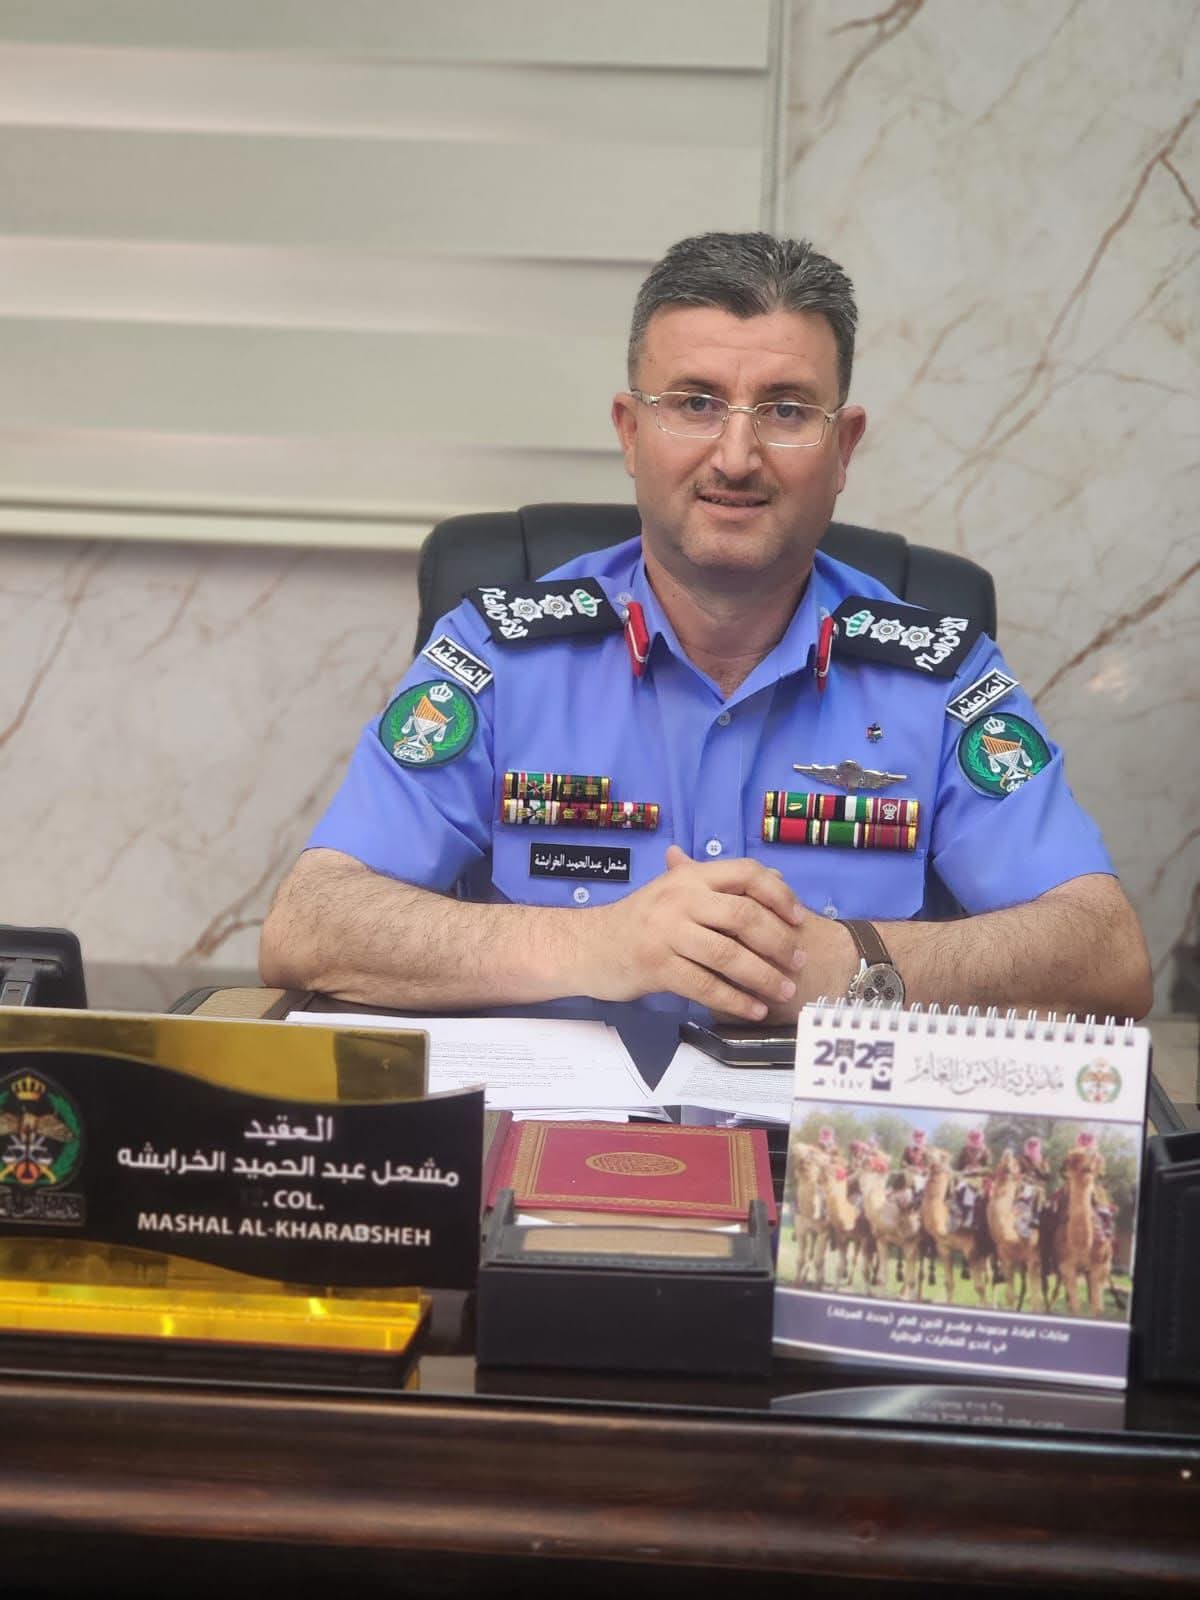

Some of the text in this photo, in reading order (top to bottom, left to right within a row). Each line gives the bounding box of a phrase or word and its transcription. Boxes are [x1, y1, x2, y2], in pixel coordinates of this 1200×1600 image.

[603, 856, 627, 874] مشعل
[243, 1114, 334, 1147] العقيد
[116, 1141, 460, 1188] مشعل عبد الحميد الخرابشه
[138, 1212, 431, 1247] MASHAL AL-KHARABSHEH
